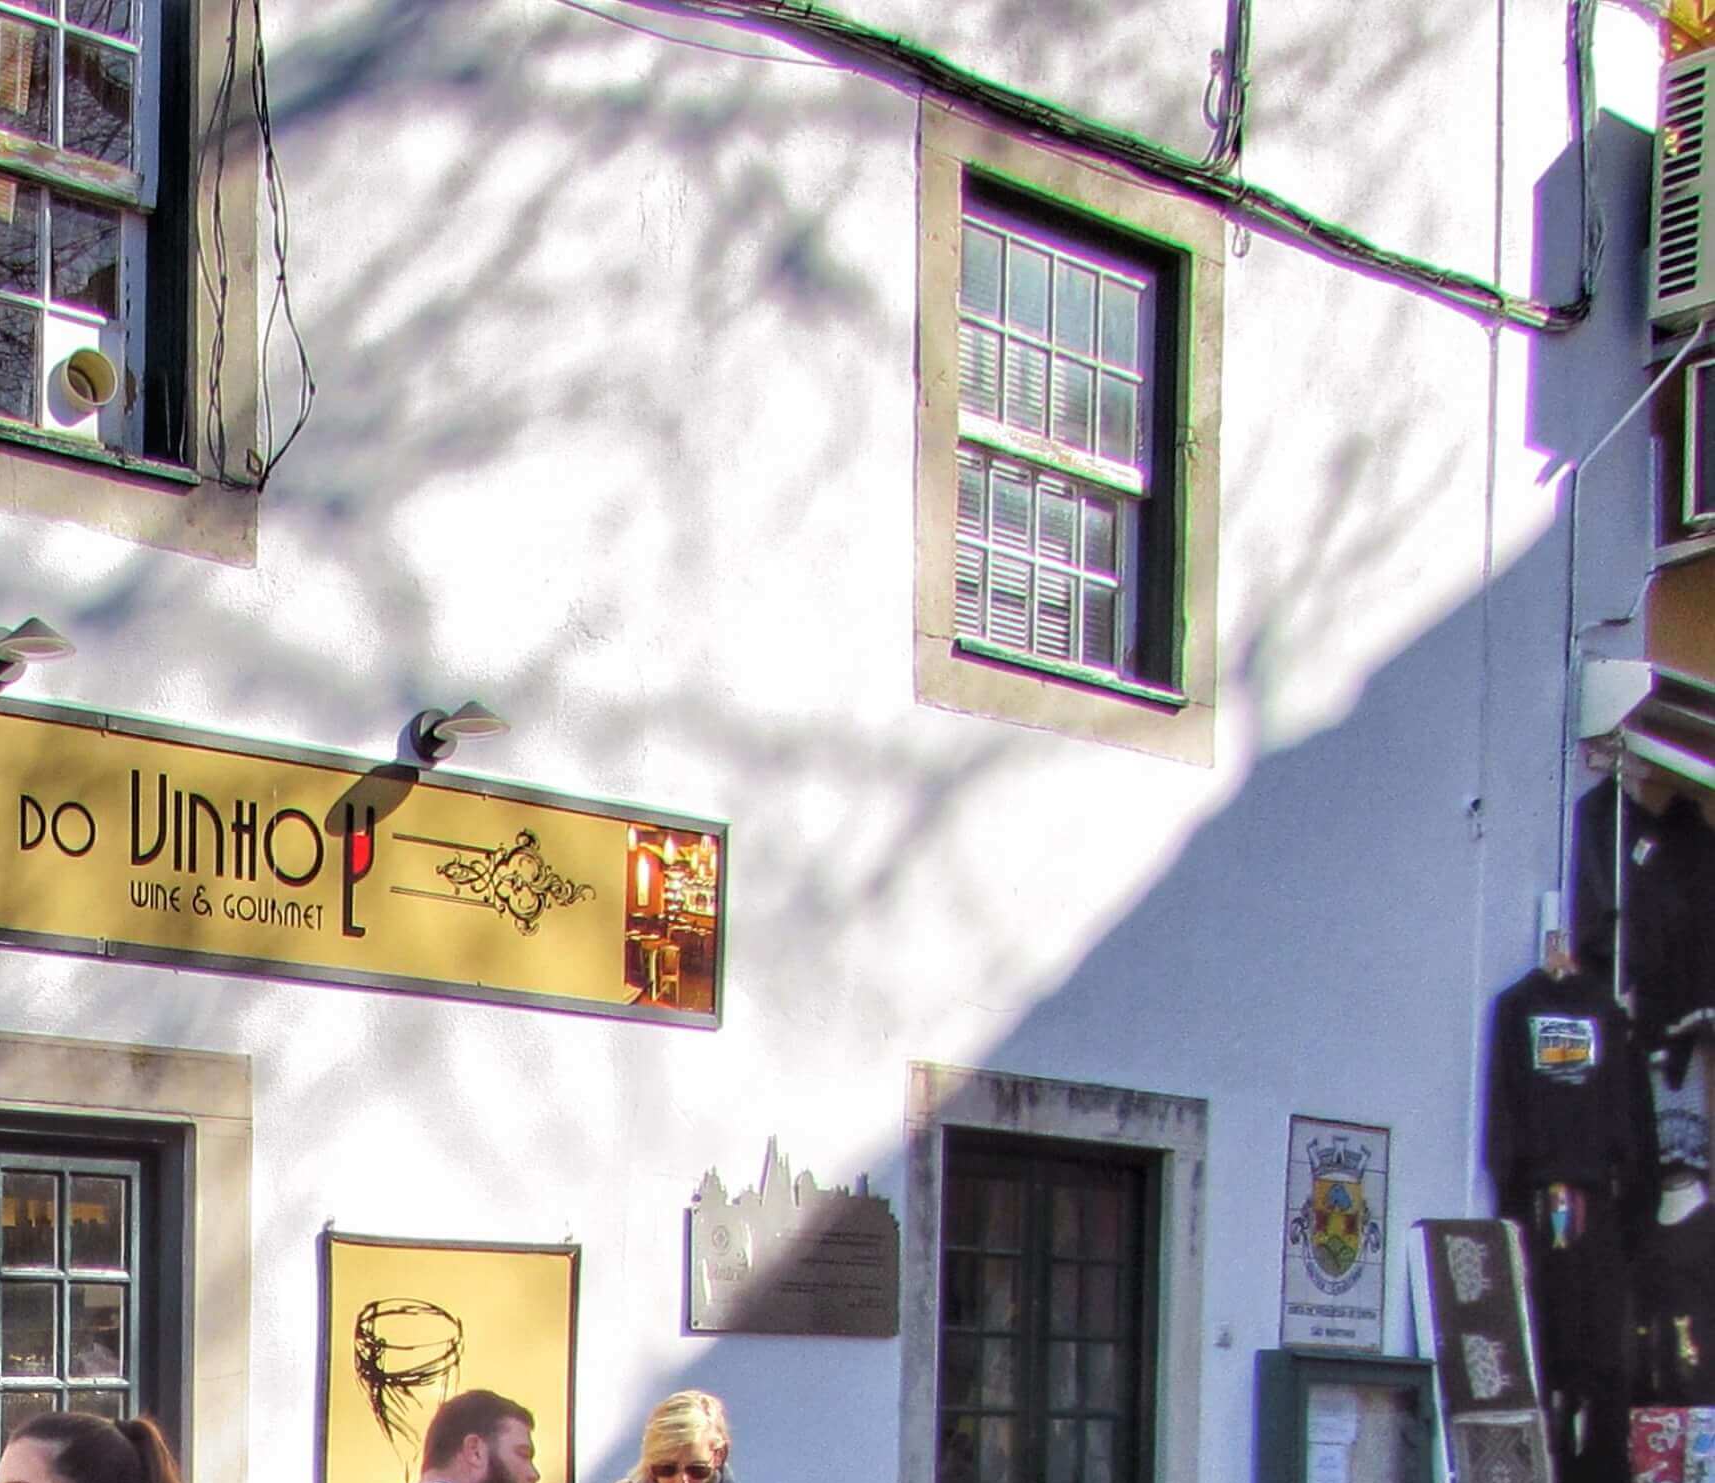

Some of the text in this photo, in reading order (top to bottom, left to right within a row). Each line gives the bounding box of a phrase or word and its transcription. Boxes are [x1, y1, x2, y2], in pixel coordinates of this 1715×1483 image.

[19, 794, 96, 857] DO
[131, 769, 324, 887] VINHO
[130, 880, 324, 930] WINE & GOURMET
